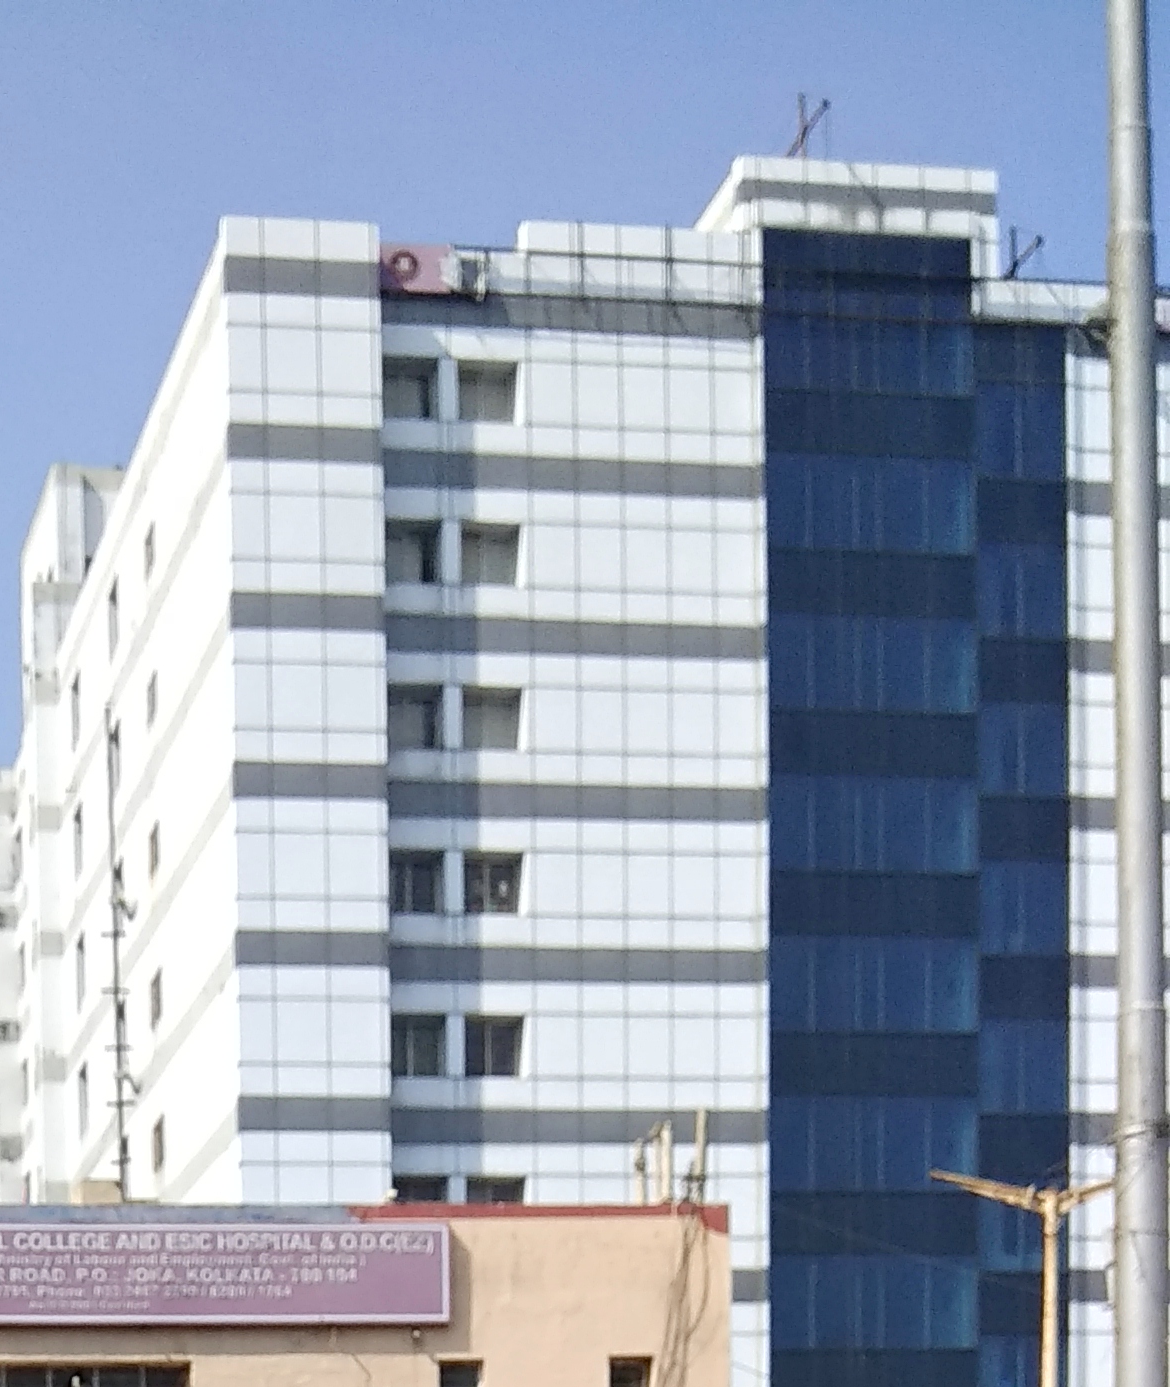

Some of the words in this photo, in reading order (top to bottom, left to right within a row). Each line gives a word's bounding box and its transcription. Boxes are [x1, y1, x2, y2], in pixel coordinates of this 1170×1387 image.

[13, 1232, 111, 1251] COLLEGE
[115, 1232, 161, 1251] AND
[164, 1232, 212, 1251] ESIC
[216, 1232, 316, 1251] HOSPITAL
[186, 1267, 274, 1283] KOLKATA
